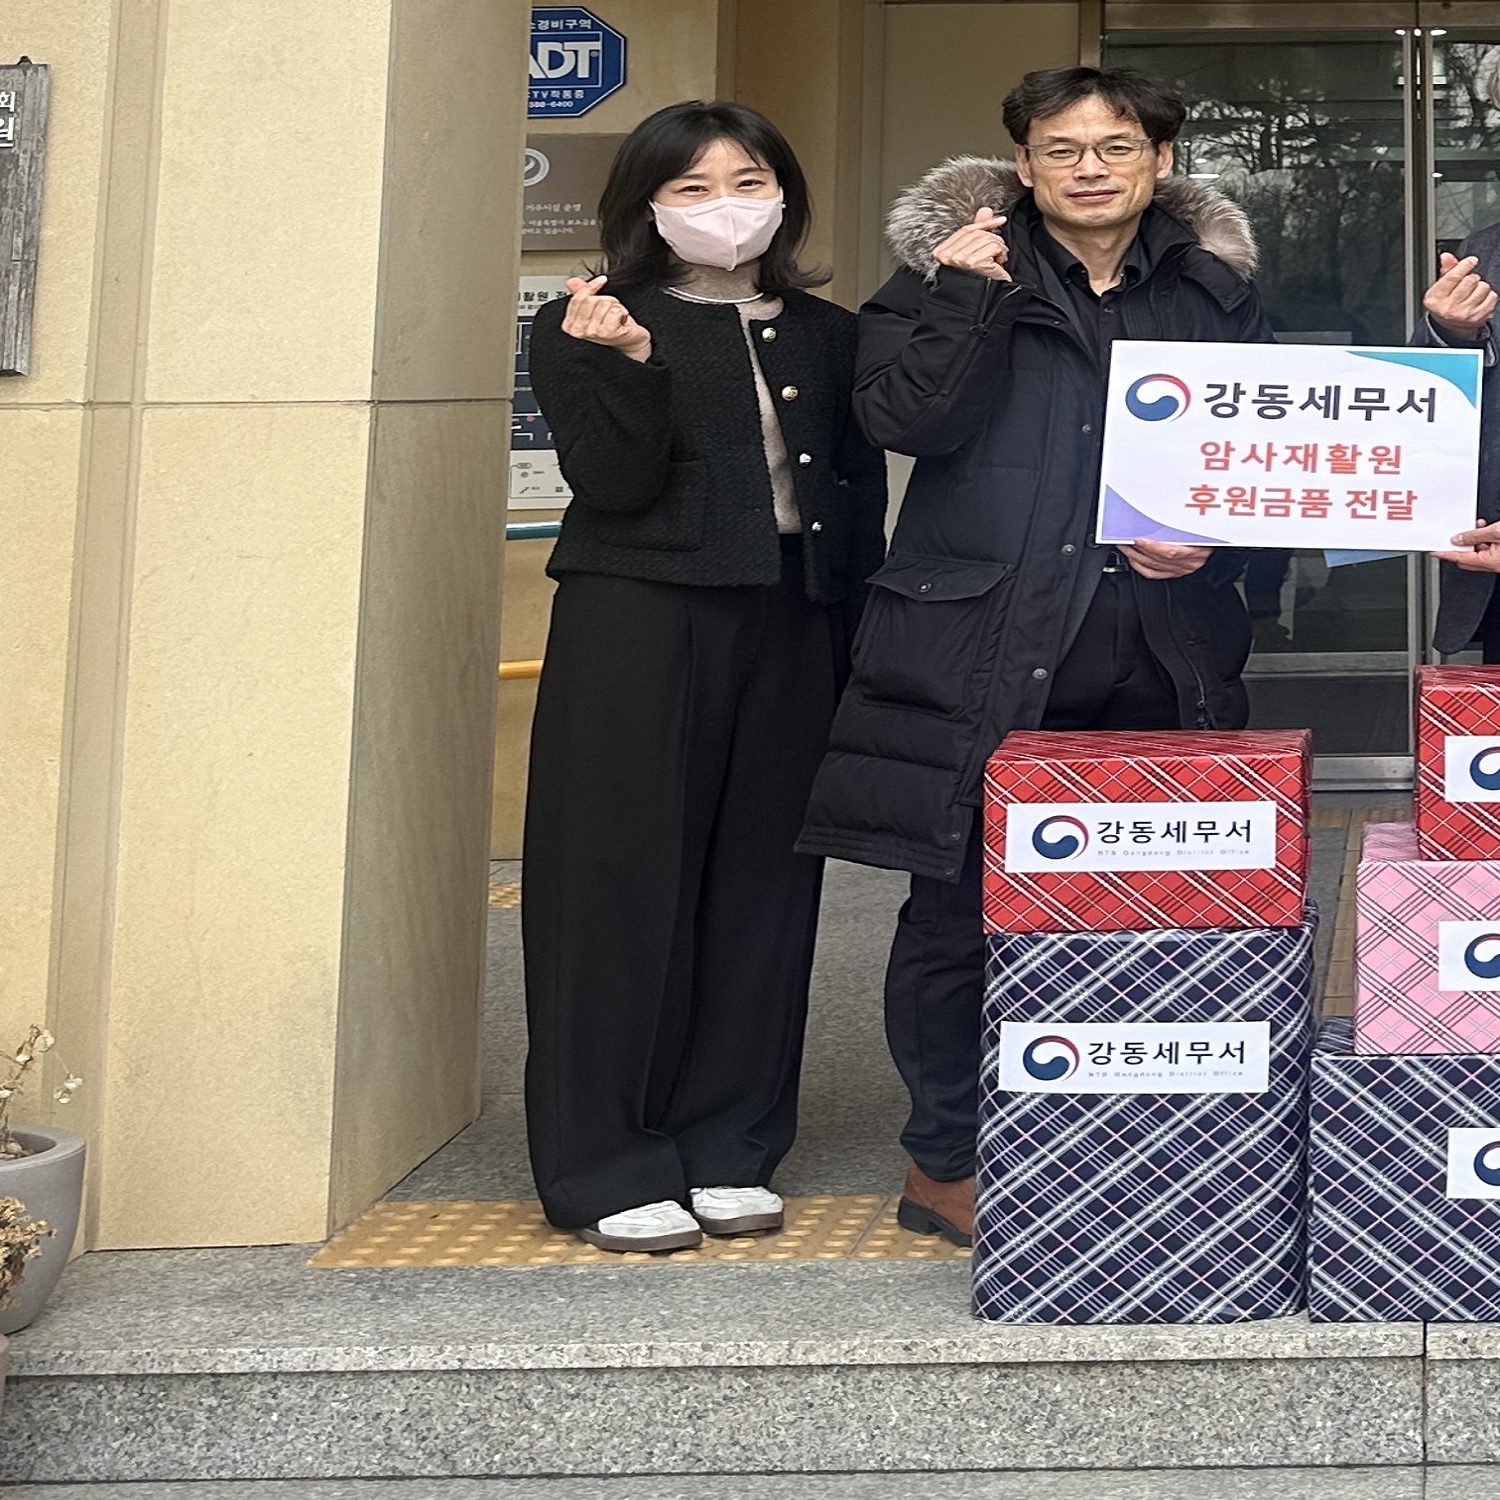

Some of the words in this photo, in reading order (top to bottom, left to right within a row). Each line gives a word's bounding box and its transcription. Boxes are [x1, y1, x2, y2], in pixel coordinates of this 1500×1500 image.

[1203, 382, 1437, 423] 강동세무서
[1200, 440, 1402, 474] 암사재활원
[1185, 484, 1333, 519] 후원금품
[1345, 489, 1418, 520] 전달
[1096, 820, 1252, 843] 강동세무서
[1088, 1041, 1245, 1065] 강동세무서
